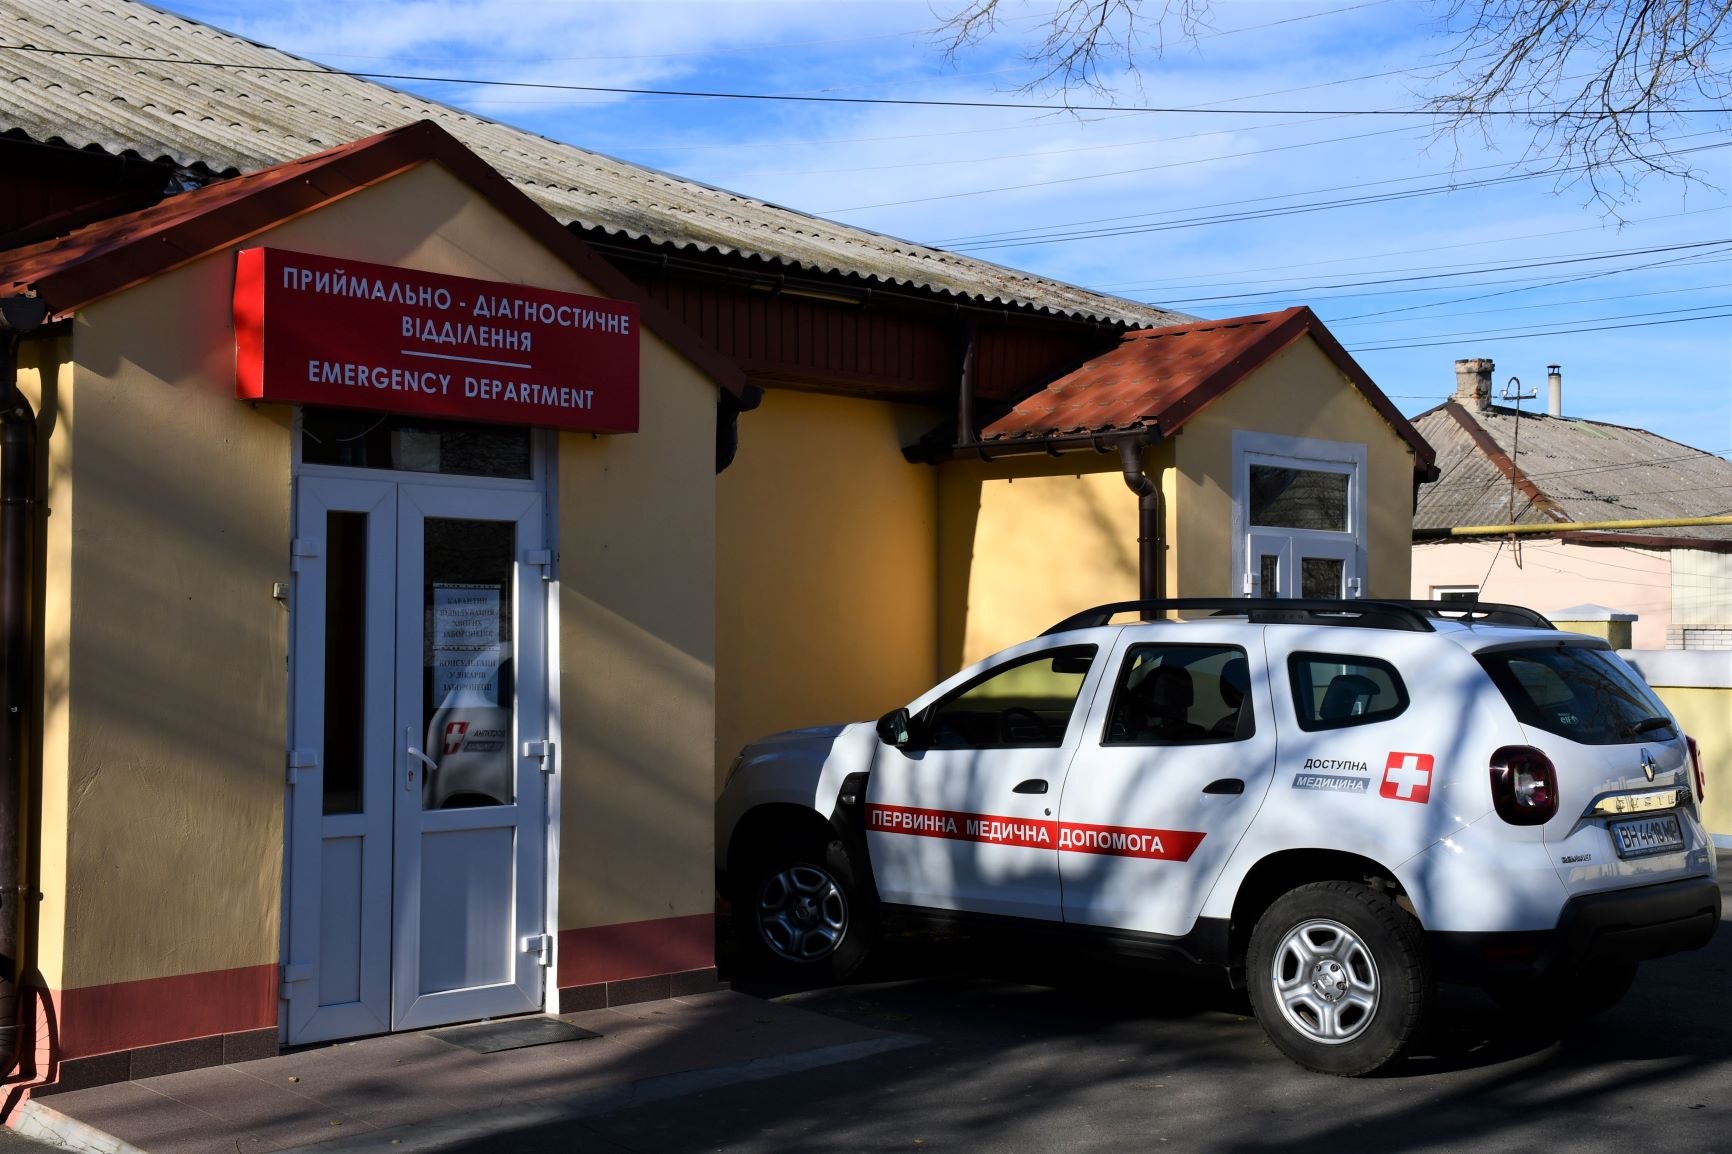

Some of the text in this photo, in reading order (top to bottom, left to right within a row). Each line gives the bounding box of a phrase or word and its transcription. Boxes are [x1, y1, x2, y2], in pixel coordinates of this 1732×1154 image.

[283, 266, 451, 310] ПРИЙМАЛЬНО
[472, 294, 630, 335] ДІАГНОСТИЧНЕ
[402, 315, 532, 352] ВІДДІЛЕННЯ
[308, 360, 594, 410] EMERGENCY DEPARTMENT
[1296, 776, 1365, 791] МЕДИЦИНА
[1303, 758, 1368, 772] ДОСТУПНА
[872, 809, 1165, 853] ПЕРВИННА МЕДИЧНА ДОПОМОГА
